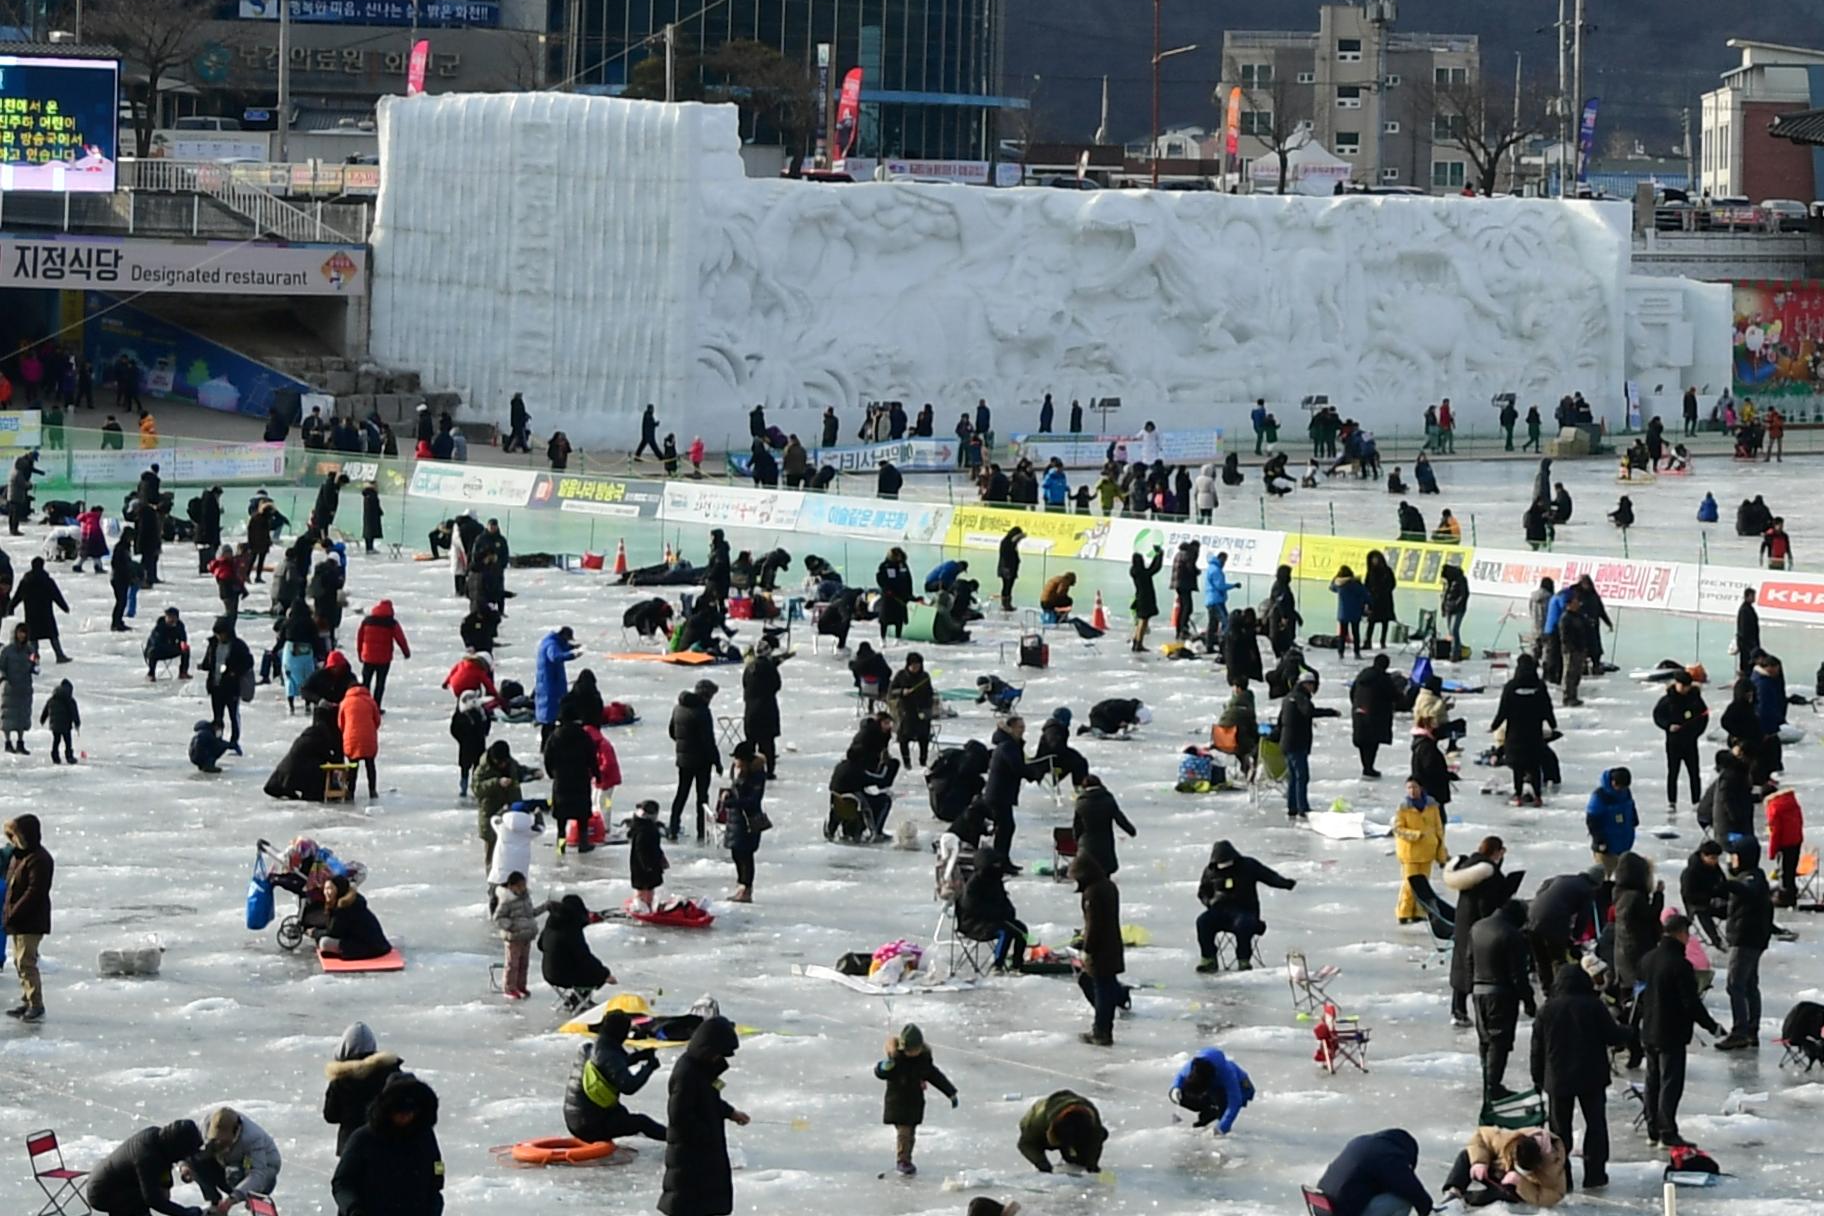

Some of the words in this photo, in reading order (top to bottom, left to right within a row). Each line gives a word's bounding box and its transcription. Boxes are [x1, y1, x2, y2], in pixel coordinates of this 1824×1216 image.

[13, 245, 123, 282] 지정식당
[131, 264, 220, 286] Designated
[224, 267, 308, 286] restaurant
